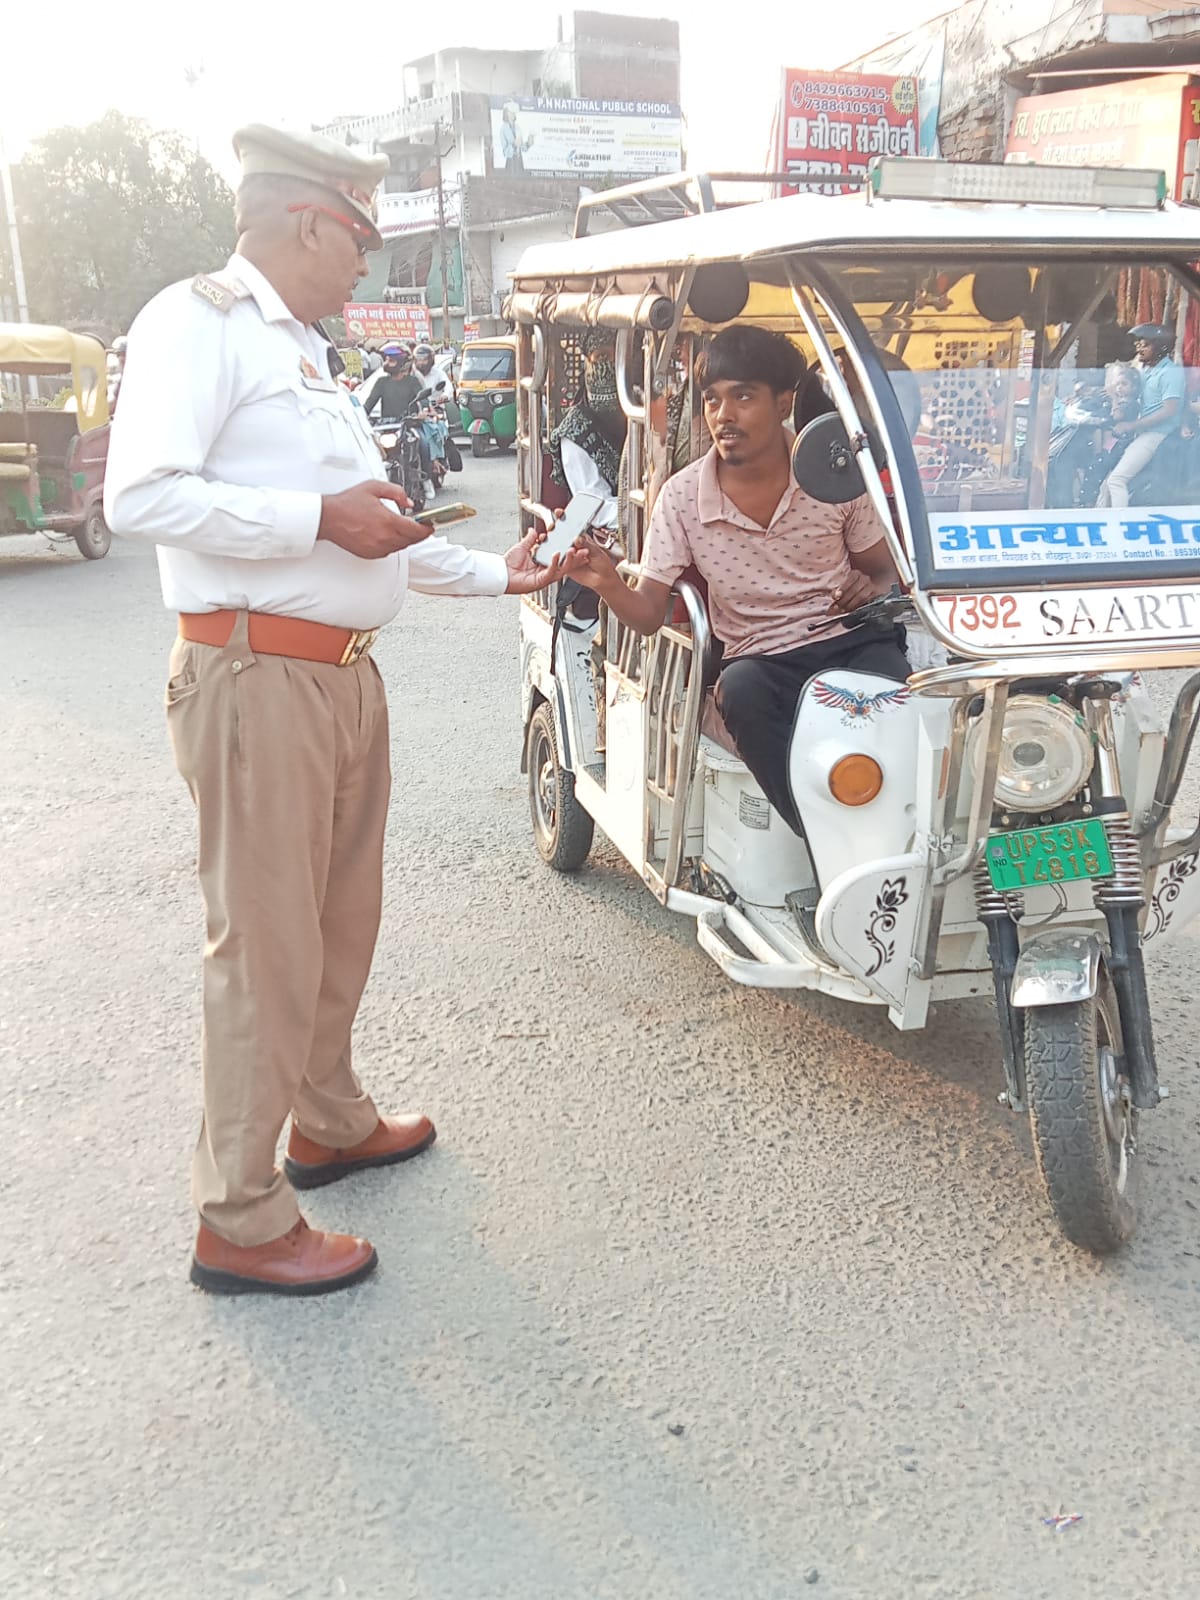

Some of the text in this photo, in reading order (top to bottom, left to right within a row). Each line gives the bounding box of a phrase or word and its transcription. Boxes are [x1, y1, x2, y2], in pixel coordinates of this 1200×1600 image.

[554, 98, 600, 112] NATIONAL
[602, 101, 634, 113] PUBLIC
[636, 102, 672, 114] SCHOOL
[804, 98, 885, 115] 7388410541
[808, 112, 853, 152] जीवन
[938, 513, 1200, 551] आन्या मो
[1123, 549, 1153, 559] Contact
[937, 591, 1200, 637] 7392 SAART
[1005, 824, 1093, 859] UP53K
[992, 857, 1008, 867] IND
[1013, 850, 1100, 884] T4818
